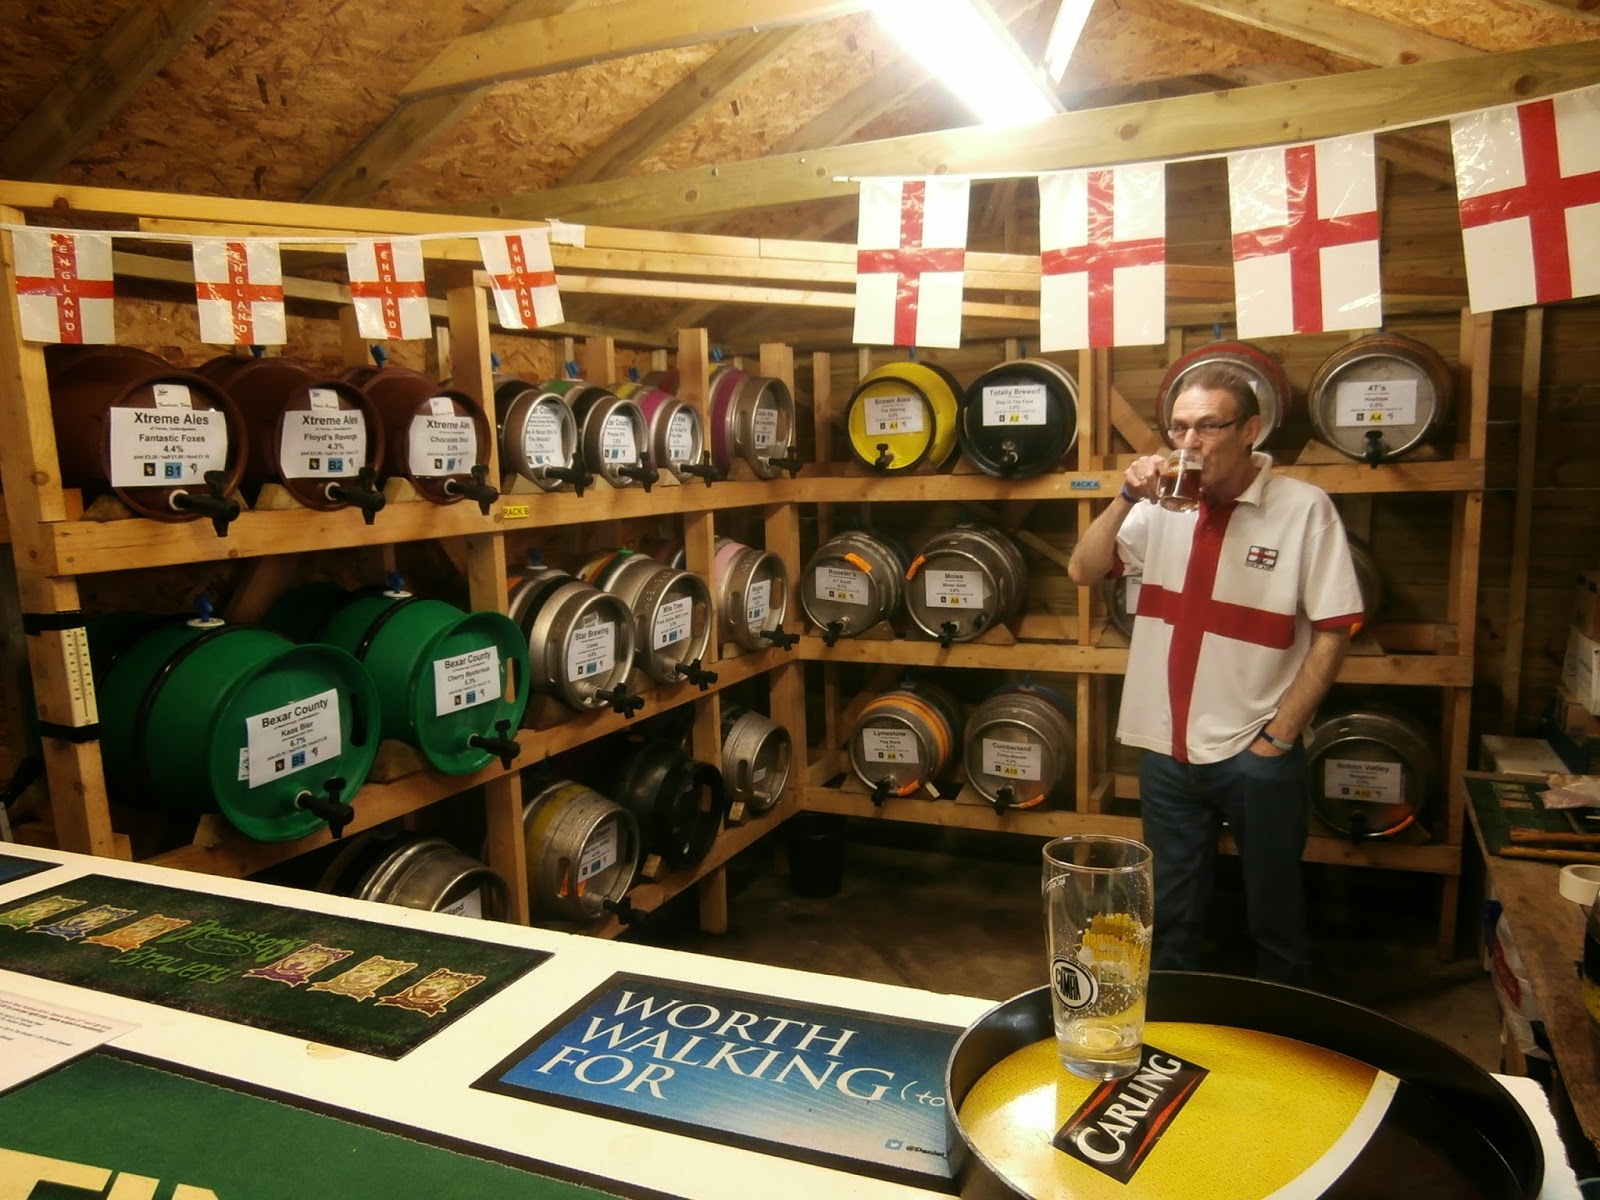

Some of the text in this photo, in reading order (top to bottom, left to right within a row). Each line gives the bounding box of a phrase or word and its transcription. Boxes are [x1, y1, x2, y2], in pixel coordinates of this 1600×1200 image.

[512, 243, 532, 319] ENGLAND
[59, 245, 76, 331] ENGLAND
[233, 251, 250, 333] ENGLAND
[380, 251, 397, 329] ENGLAND
[990, 389, 1012, 397] Totally
[134, 411, 209, 425] Xtreme Ales
[302, 415, 358, 425] Xtreme Ales
[427, 419, 458, 429] Xtreme
[139, 433, 205, 442] Fantastic Foxes
[303, 433, 333, 442] Floyd's
[163, 445, 184, 453] 4.4%
[165, 465, 181, 476] B1
[329, 460, 343, 470] B2
[503, 508, 523, 516] RACK
[828, 568, 857, 577] Rooster's
[574, 627, 609, 641] Star Brewing
[444, 658, 466, 669] Bexar
[467, 651, 491, 663] County
[447, 674, 464, 682] Cherry
[261, 711, 292, 728] Bexar
[294, 699, 329, 716] County
[299, 720, 314, 730] Bier
[289, 737, 306, 747] 6.7%
[992, 742, 1031, 752] Cumberland
[108, 945, 243, 984] Brewery
[1055, 966, 1081, 1001] CAMRA
[613, 990, 859, 1058] WORTH
[580, 1016, 897, 1101] WALKING
[533, 1045, 677, 1101] FOR
[1076, 1053, 1183, 1164] CARLING
